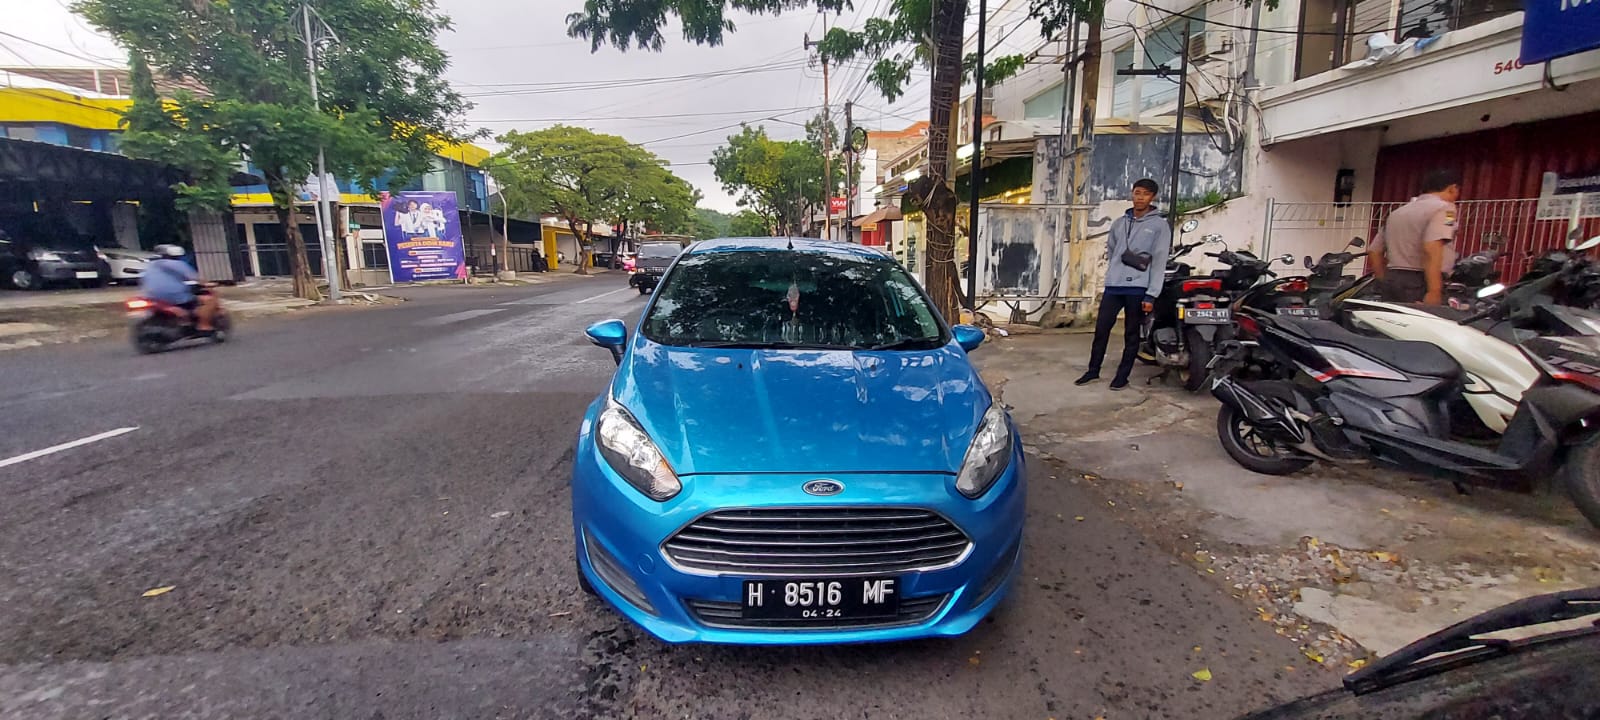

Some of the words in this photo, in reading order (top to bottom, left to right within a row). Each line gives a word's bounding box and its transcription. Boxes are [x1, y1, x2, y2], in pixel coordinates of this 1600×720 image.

[812, 482, 835, 493] Ford
[748, 582, 764, 607] H
[784, 581, 842, 607] 8516
[862, 579, 894, 604] MF
